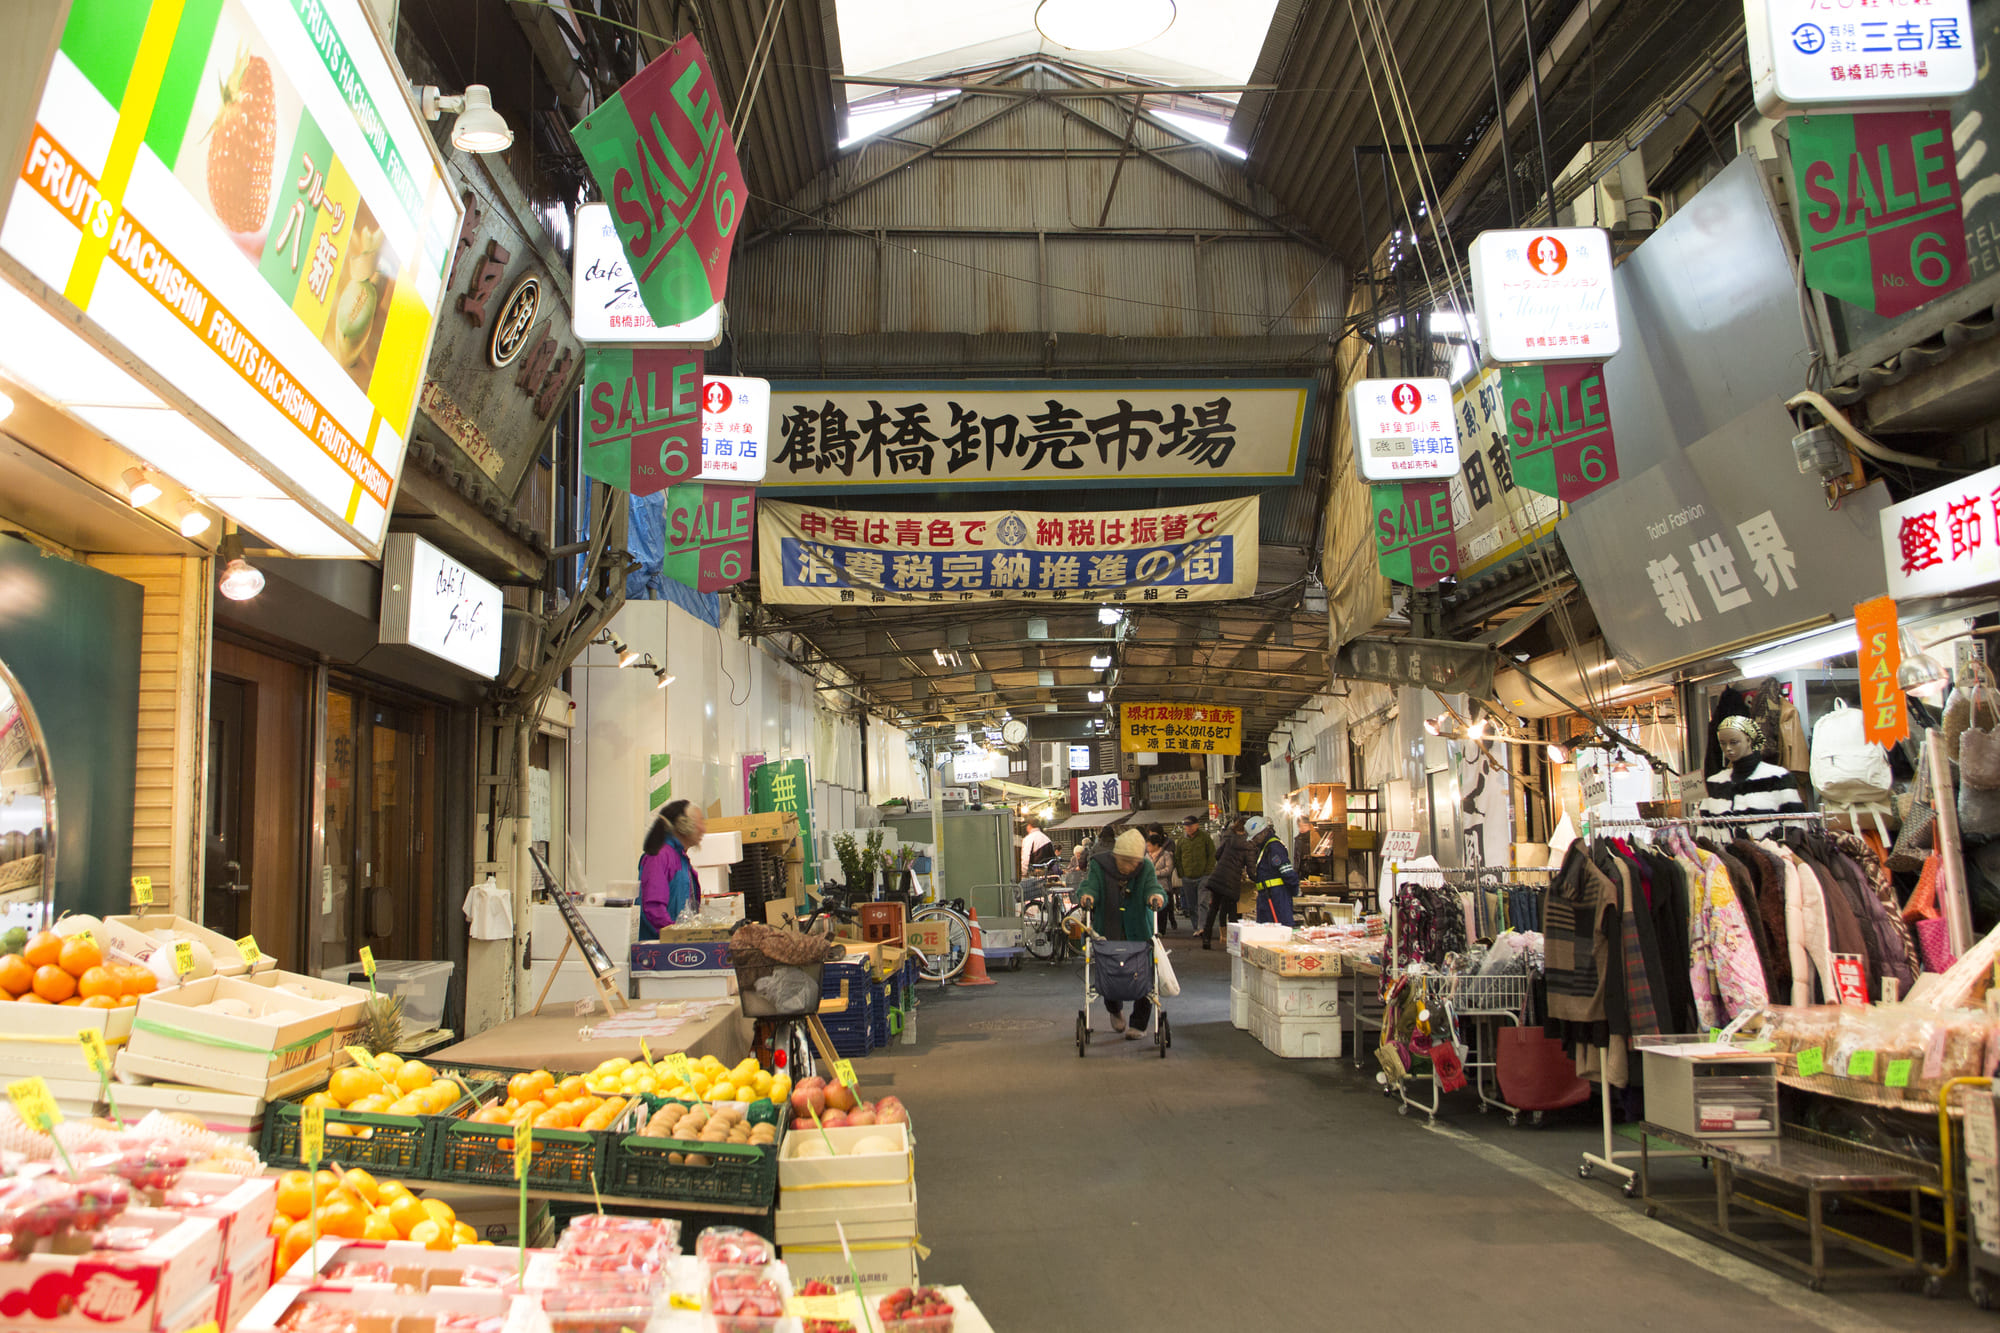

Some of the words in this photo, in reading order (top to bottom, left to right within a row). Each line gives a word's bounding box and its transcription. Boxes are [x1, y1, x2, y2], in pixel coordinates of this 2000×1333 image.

[1830, 61, 1928, 81] 鶴橋卸売市場
[613, 60, 721, 258] SALE
[1805, 128, 1952, 234] SALE
[298, 151, 346, 236] フルーツ
[1910, 232, 1950, 287] 6
[27, 136, 113, 238] FRUITS
[110, 211, 208, 328] HACHISHIN
[207, 311, 259, 376] FRUITS
[255, 354, 316, 432] HACHISHIN
[316, 415, 351, 461] FRUITS
[348, 445, 391, 503] HACHISHIN
[589, 362, 698, 435] SALE
[1511, 376, 1607, 448] SALE
[660, 436, 689, 476] 6
[773, 397, 1236, 477] 鶴橋卸売市場
[1579, 445, 1607, 482] 6
[669, 496, 750, 547] SALE
[800, 512, 987, 547] 申告は青色で
[1036, 511, 1218, 547] 納税は振替で
[1378, 494, 1450, 547] SALE
[1646, 520, 1668, 542] Total
[1669, 502, 1705, 530] Fashion
[720, 551, 741, 580] 6
[797, 541, 1222, 592] 消費税完納推進の街
[1429, 545, 1450, 573] 6
[1646, 510, 1799, 628] 新世界
[1868, 632, 1897, 730] SALE
[1131, 723, 1233, 738] 日本で一番よく切れる包丁
[1080, 777, 1119, 807] 越前
